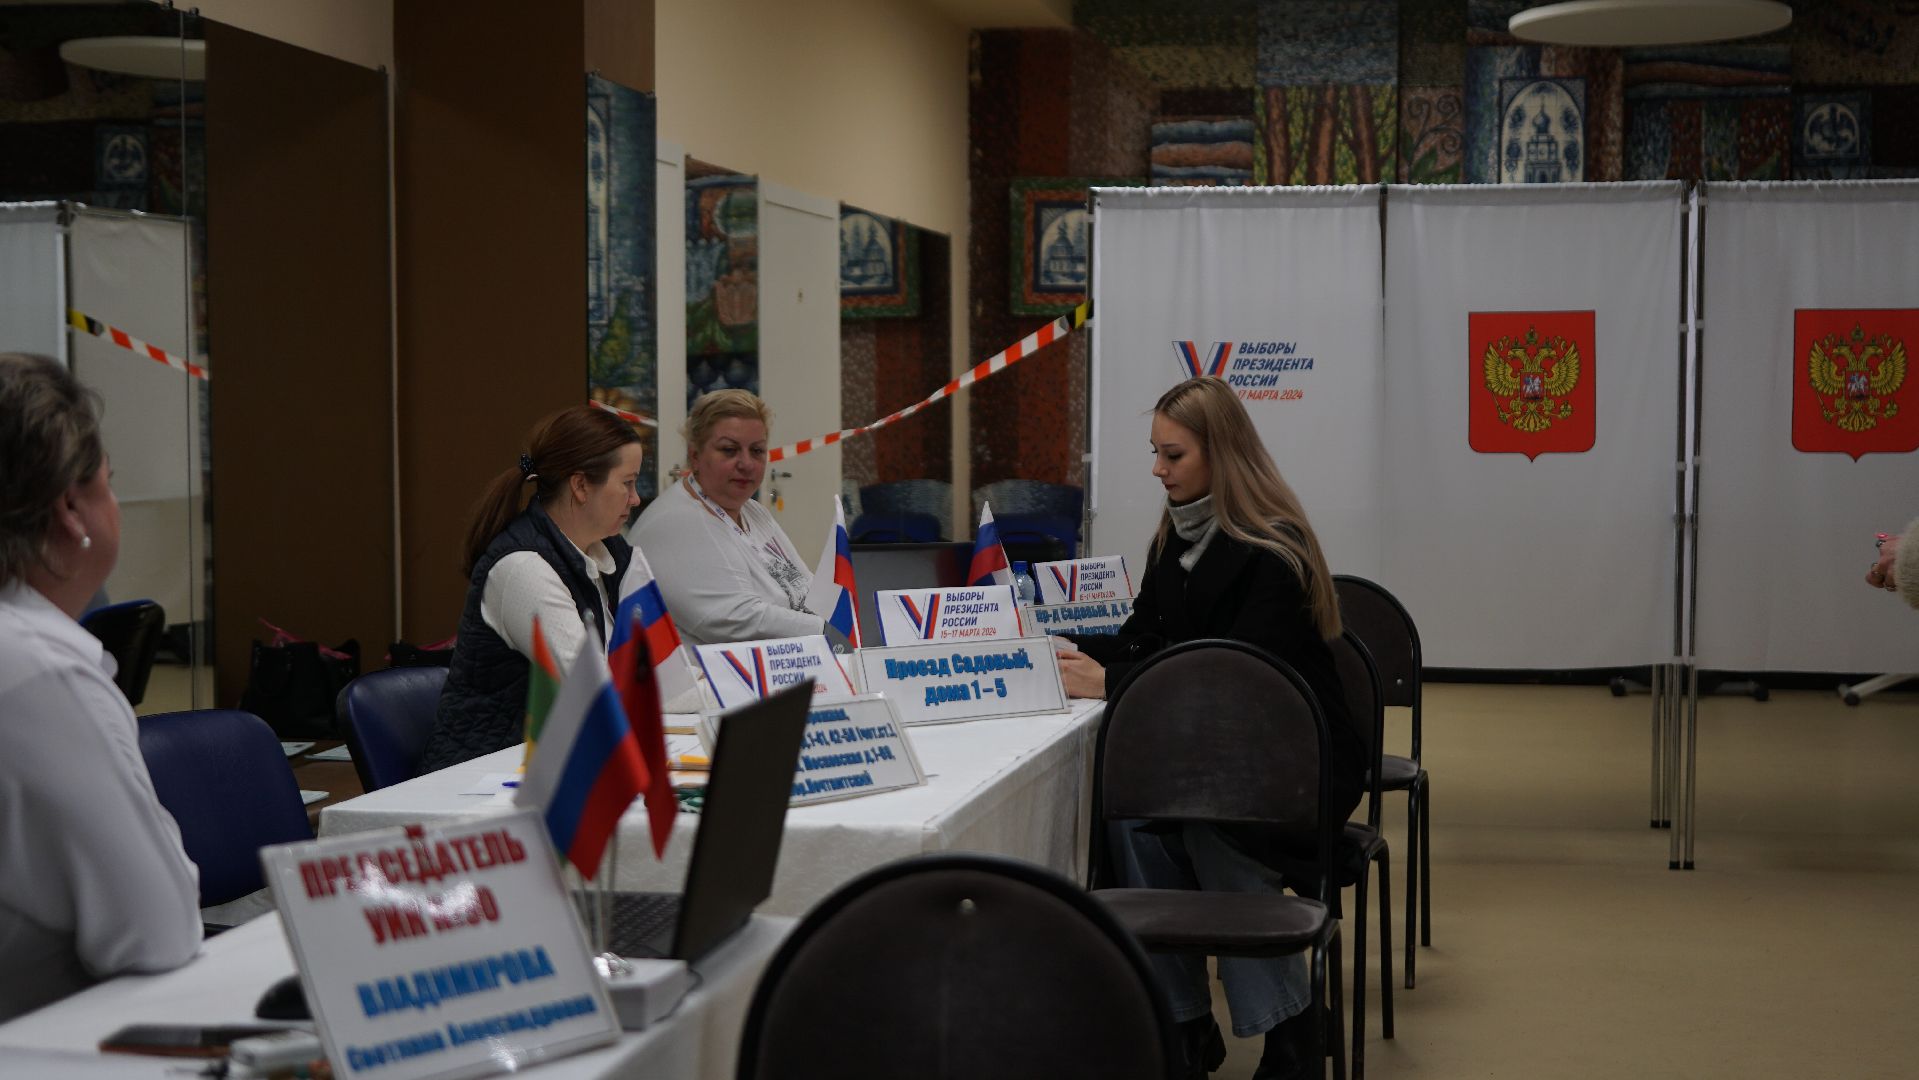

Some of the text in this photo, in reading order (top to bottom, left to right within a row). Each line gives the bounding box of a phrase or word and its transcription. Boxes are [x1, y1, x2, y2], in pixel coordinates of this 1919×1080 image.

[1238, 342, 1297, 355] ВЫБОРЫ
[1233, 358, 1314, 372] ПРЕЗИДЕНТА
[1229, 374, 1279, 386] РОССИИ
[1247, 390, 1279, 400] МАРТА
[1280, 390, 1304, 400] 2024
[1080, 562, 1106, 571] ВЫБОРЫ
[1080, 572, 1116, 581] ПРЕЗИДЕНТА
[1079, 582, 1103, 592] РОССИИ
[946, 591, 984, 602] ВЫБОРЫ
[944, 603, 999, 614] ПРЕЗИДЕНТА
[941, 617, 977, 628] РОССИИ
[959, 628, 981, 638] МАРТА
[982, 627, 997, 637] 2024
[766, 642, 804, 656] ВЫБОРЫ
[769, 656, 822, 671] ПРЕЗИДЕНТА
[951, 648, 1033, 675] Садовый,
[884, 656, 951, 681] Проезд
[772, 672, 806, 686] РОССИИ
[924, 682, 971, 707] дома
[356, 945, 555, 1019] ВЛАДИМИРОВА
